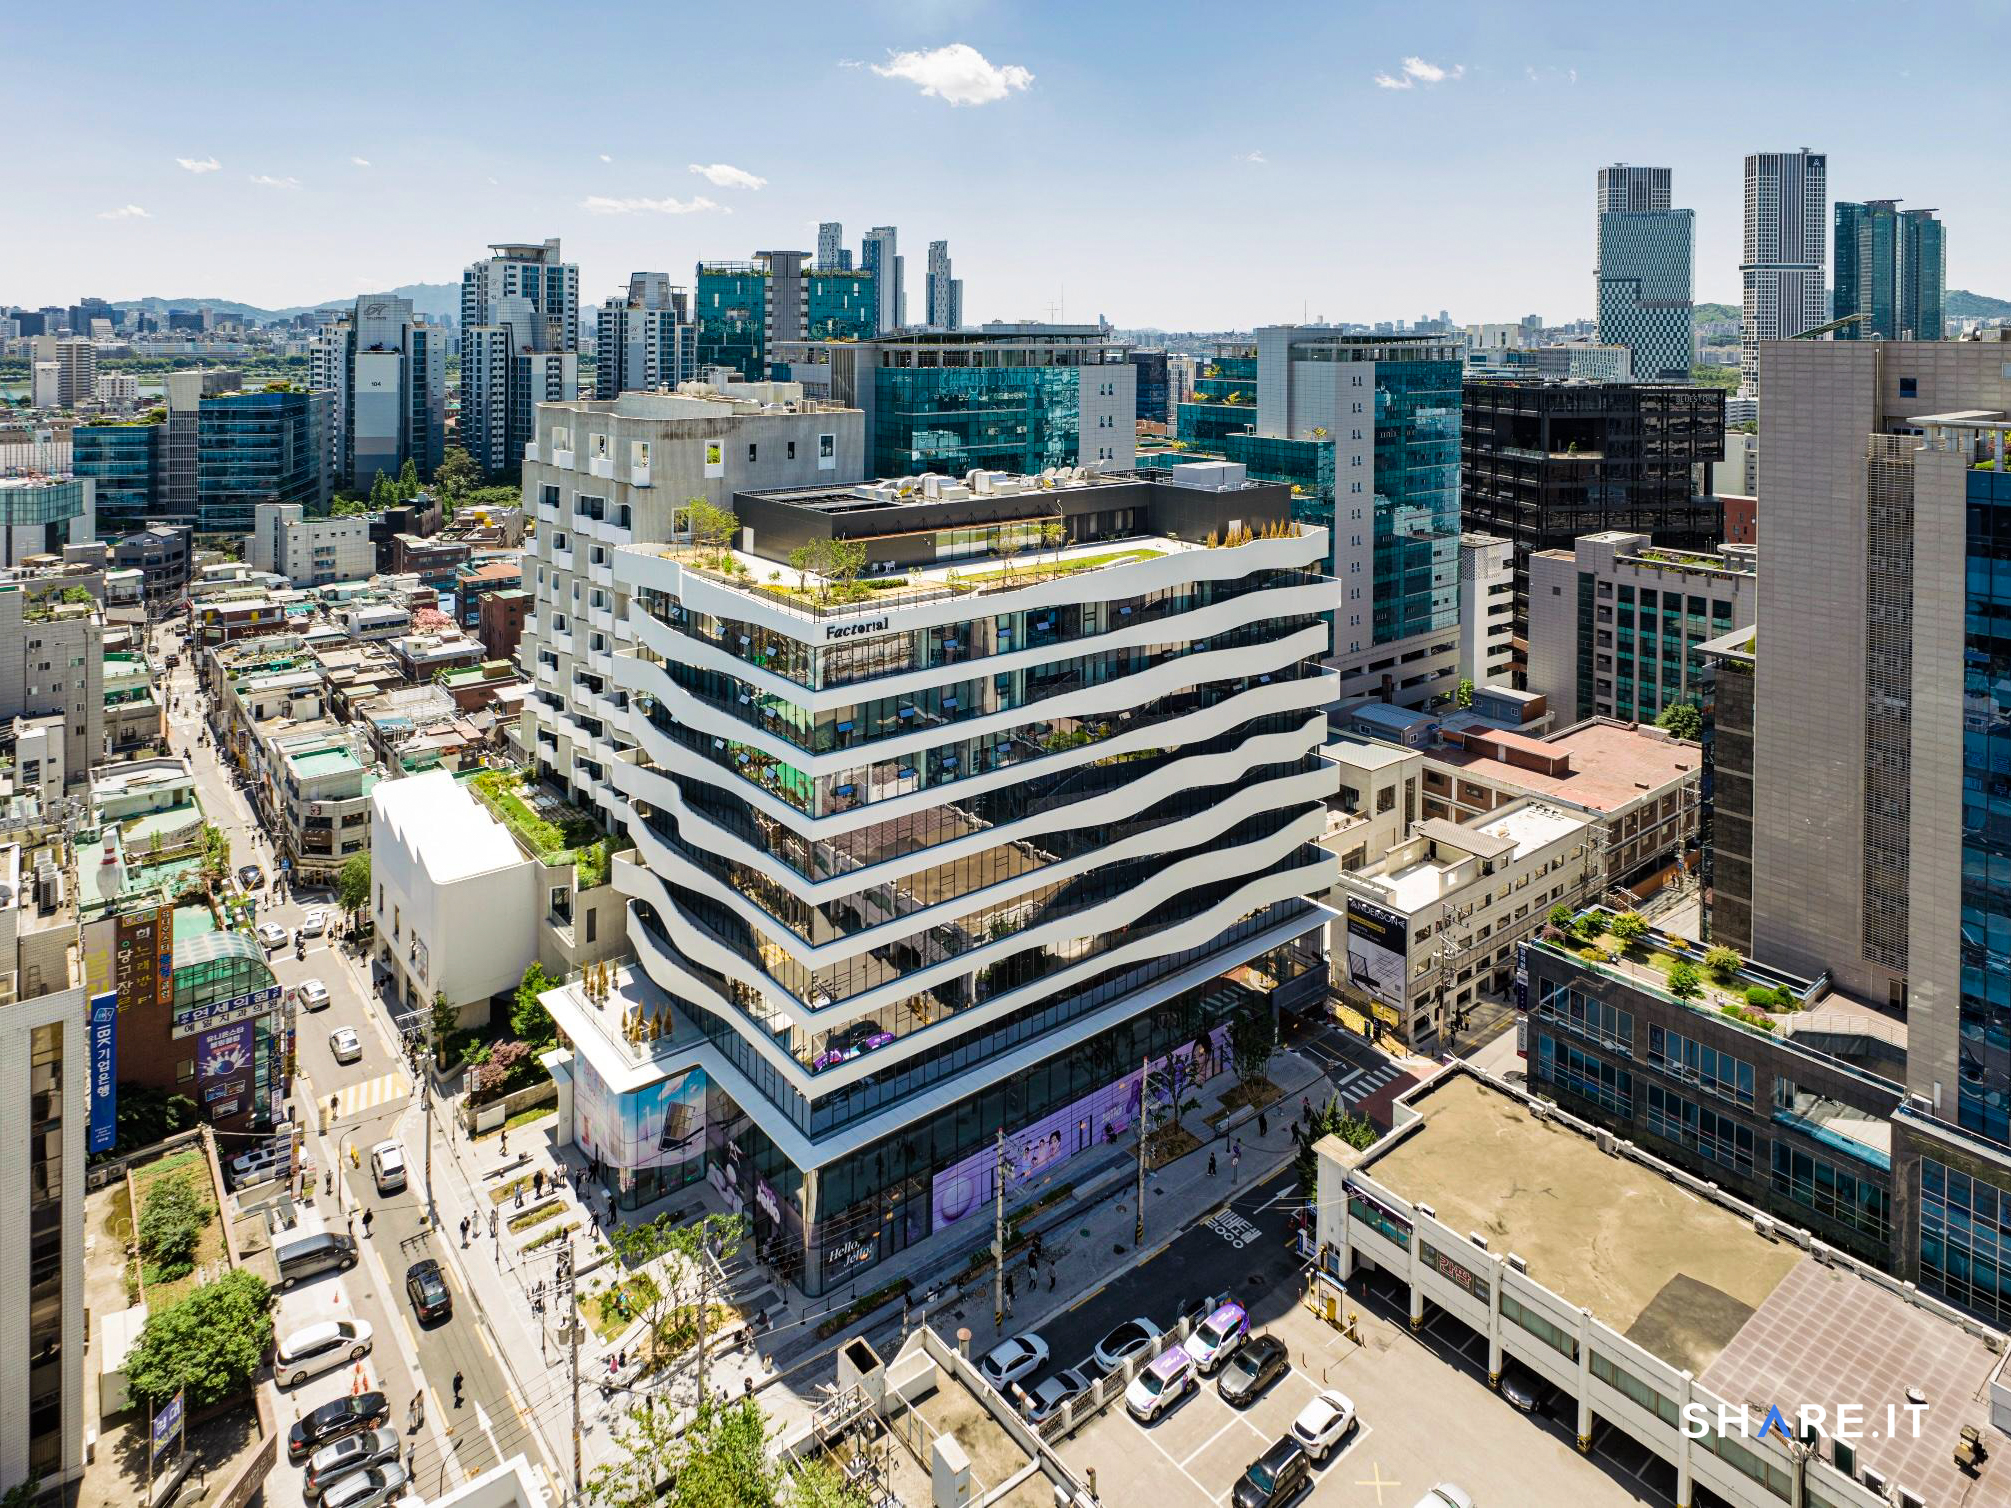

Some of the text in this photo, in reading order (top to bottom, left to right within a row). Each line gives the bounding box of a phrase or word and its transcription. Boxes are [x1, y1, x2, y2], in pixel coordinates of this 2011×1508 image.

[117, 948, 134, 996] 당구장
[192, 991, 270, 1021] 연세의원
[96, 1024, 111, 1097] IBK 기업은행
[828, 1240, 861, 1263] Hello,
[843, 1242, 873, 1268] Jello!
